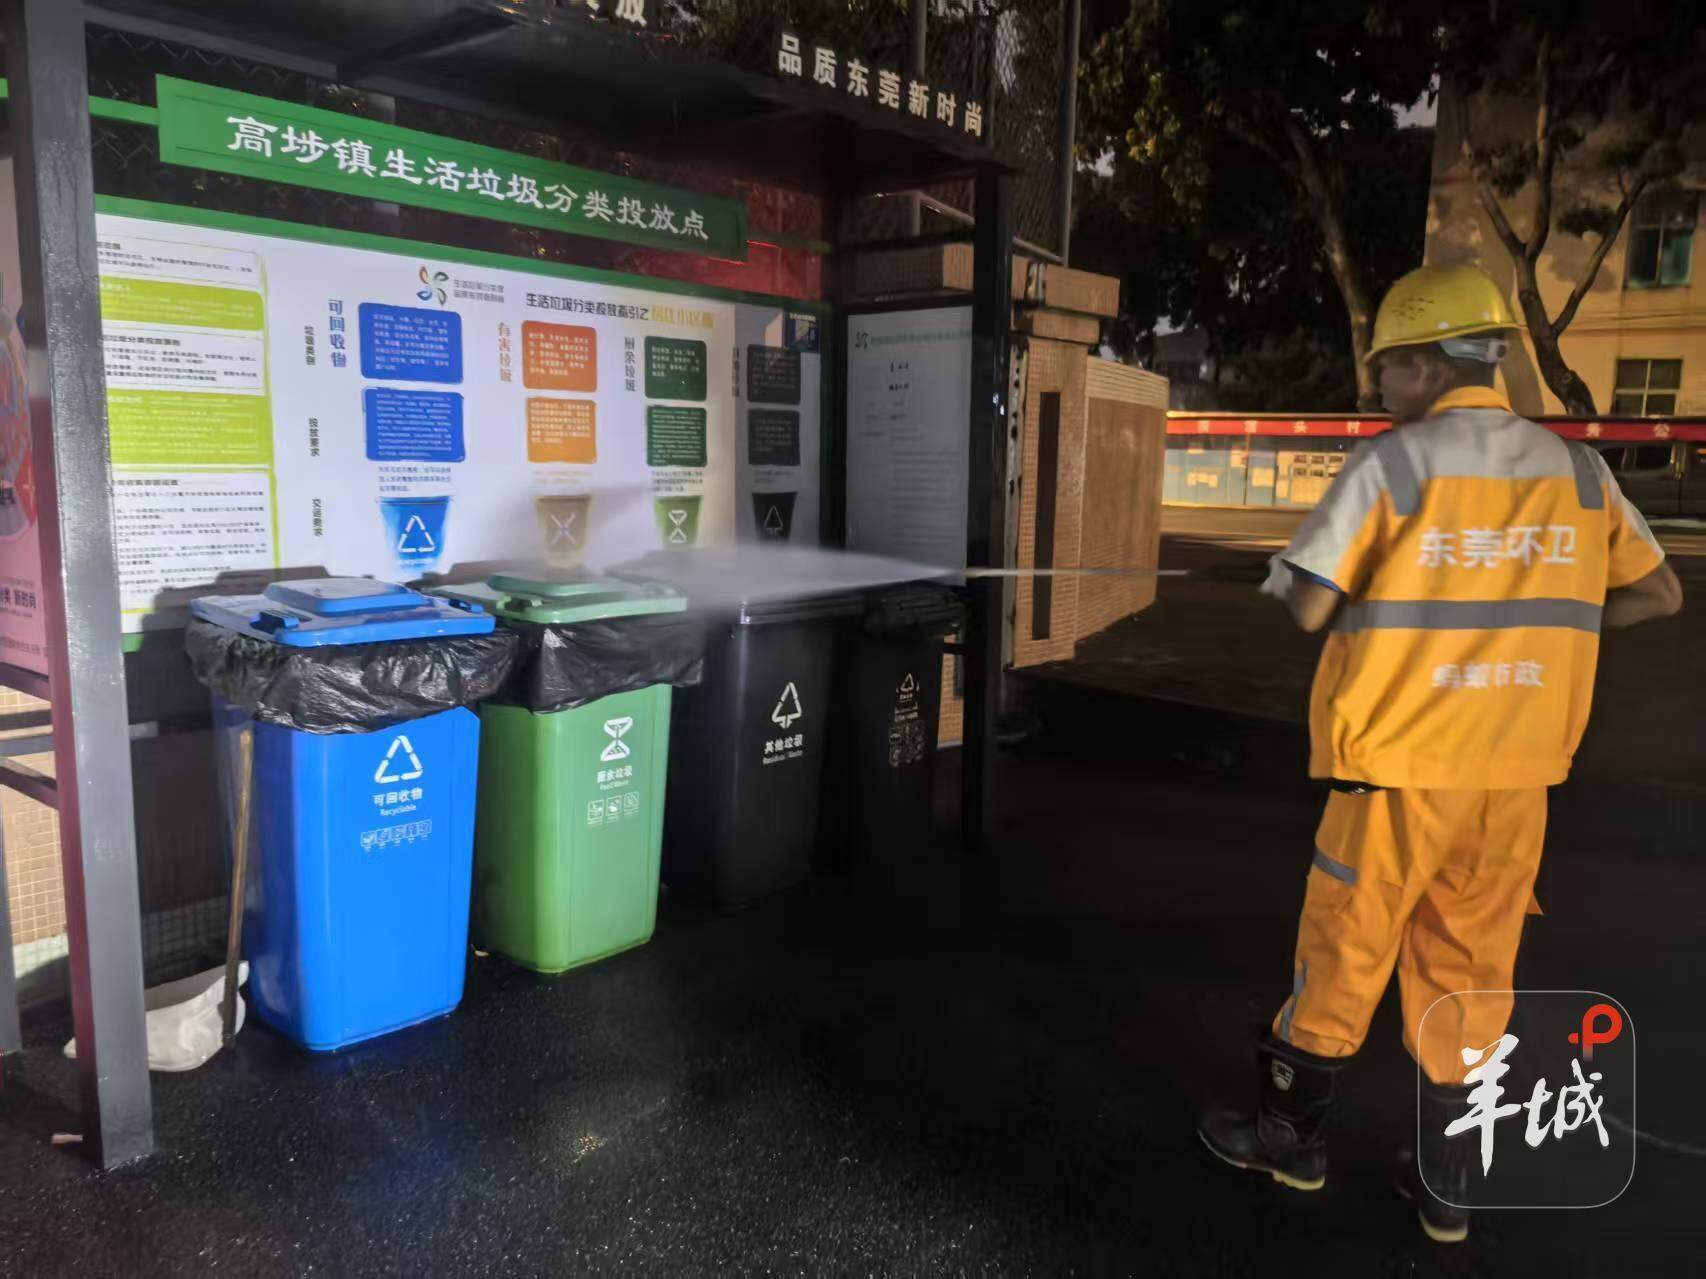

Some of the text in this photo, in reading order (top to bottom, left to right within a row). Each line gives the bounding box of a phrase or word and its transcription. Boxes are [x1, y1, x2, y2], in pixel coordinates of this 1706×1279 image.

[778, 33, 983, 138] 品质东莞新时尚
[227, 115, 709, 241] 高埗镇生活垃圾分类投放点
[328, 299, 347, 368] 可回收物
[1417, 526, 1577, 568] 东莞环卫
[371, 787, 424, 807] 可回收物
[379, 803, 417, 817] Recyclable
